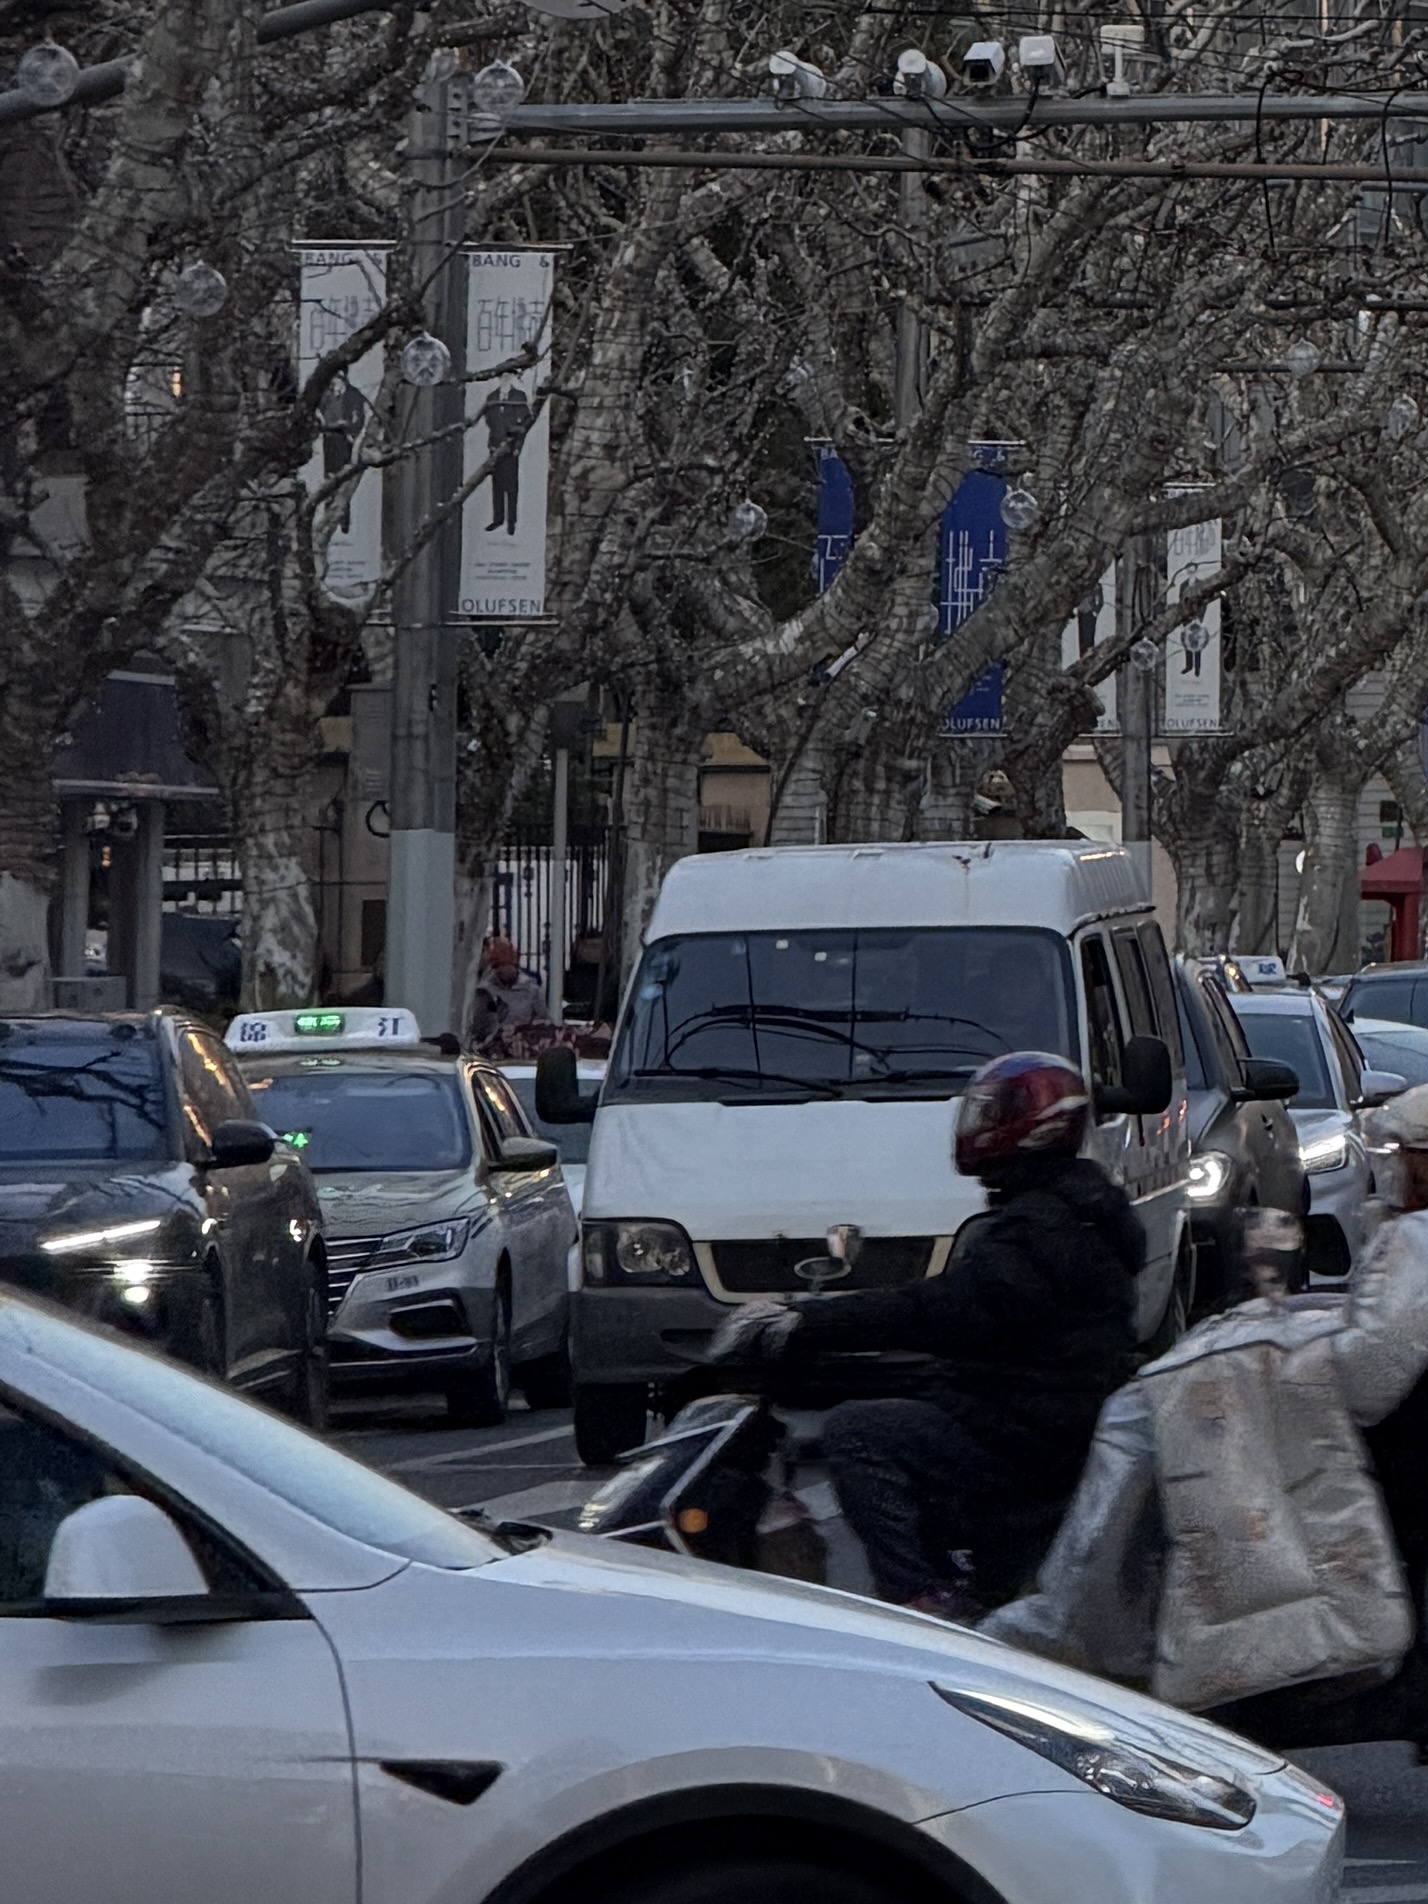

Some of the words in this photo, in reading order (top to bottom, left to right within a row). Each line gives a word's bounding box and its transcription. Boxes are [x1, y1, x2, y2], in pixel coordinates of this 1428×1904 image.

[473, 255, 521, 269] BANG
[538, 255, 550, 269] &
[462, 599, 542, 614] OLUFSEN
